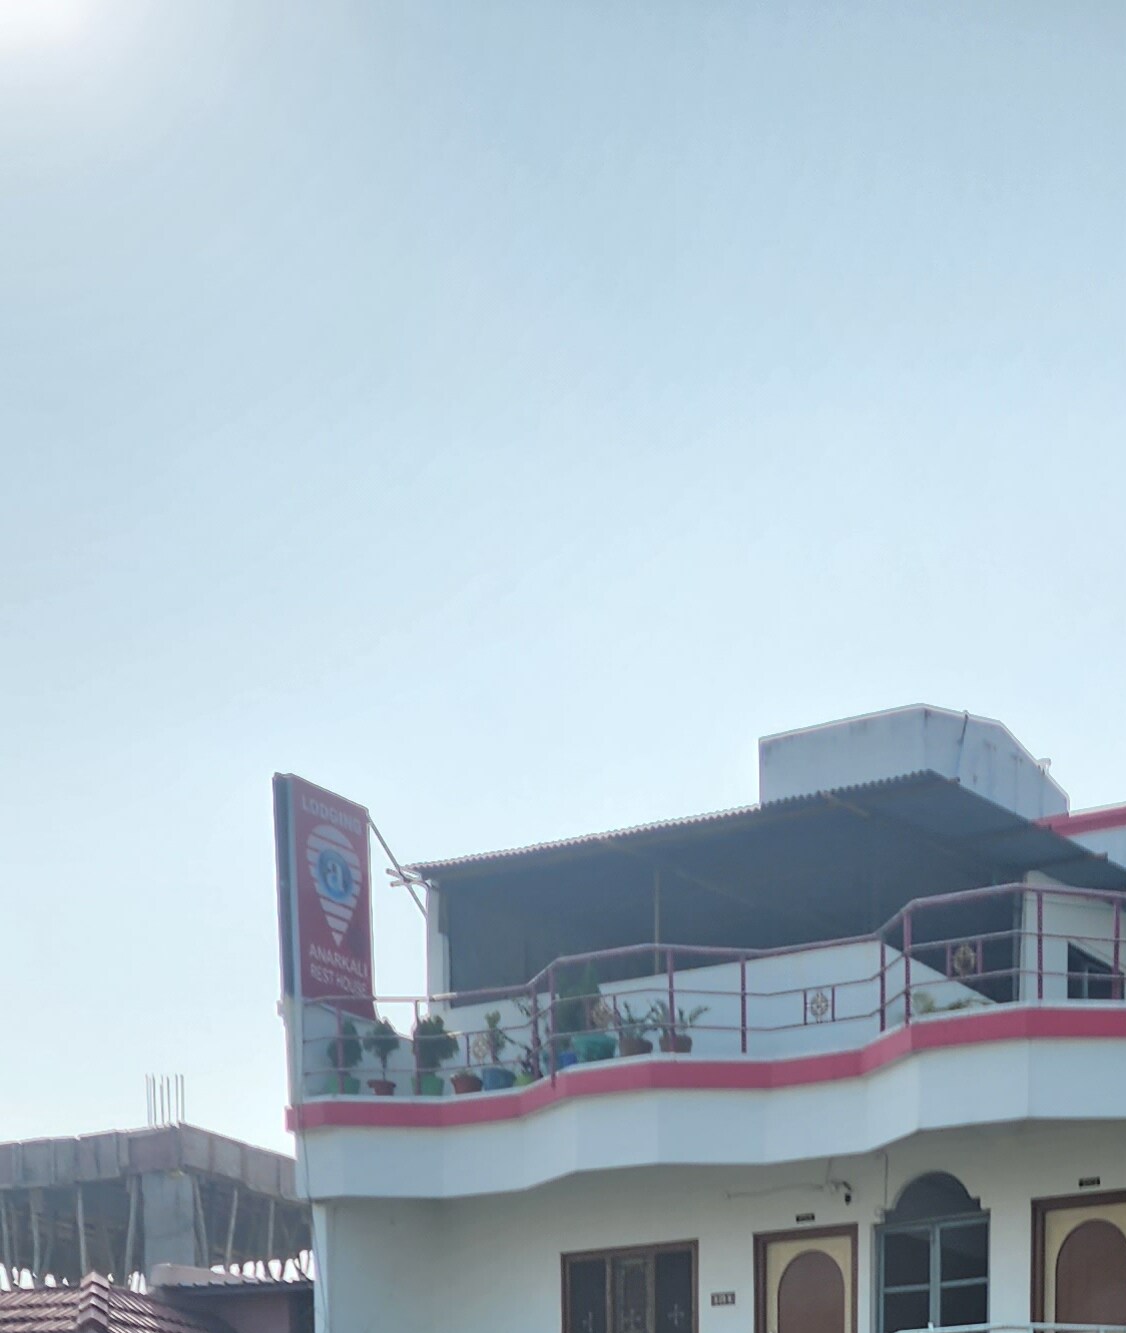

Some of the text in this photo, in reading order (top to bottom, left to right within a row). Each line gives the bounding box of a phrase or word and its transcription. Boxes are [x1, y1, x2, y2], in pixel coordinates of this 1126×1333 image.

[302, 795, 363, 834] LODGING
[308, 944, 369, 978] ANARKALI
[310, 962, 369, 998] REST HOUSE
